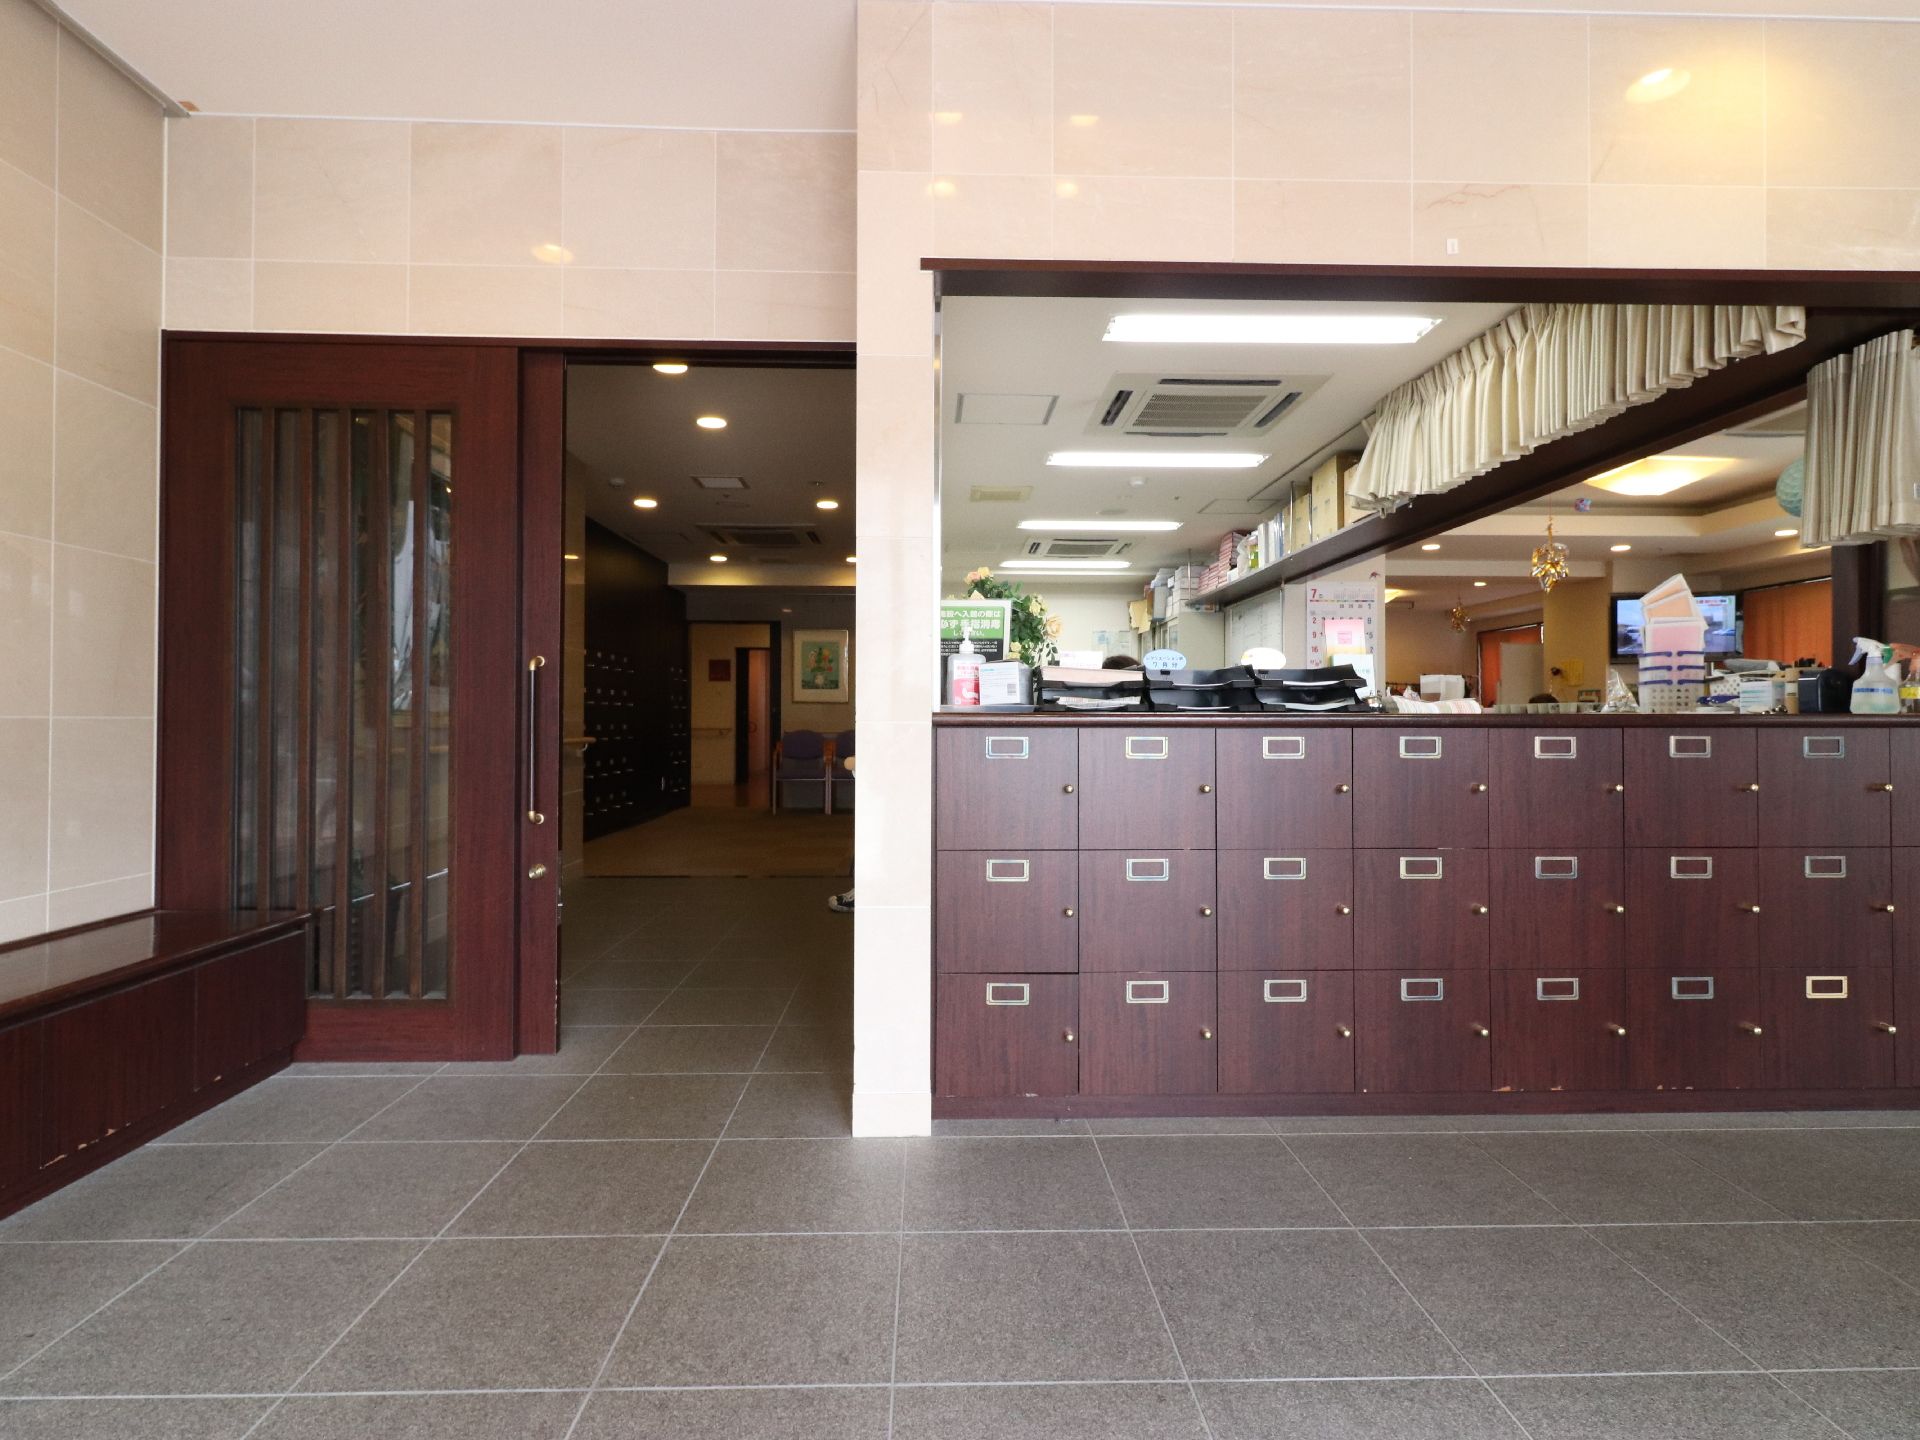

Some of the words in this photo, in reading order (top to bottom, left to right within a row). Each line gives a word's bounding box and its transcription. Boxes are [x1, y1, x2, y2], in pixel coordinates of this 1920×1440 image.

[1311, 588, 1317, 598] 7
[1312, 616, 1317, 624] 2
[1312, 631, 1317, 639] 9
